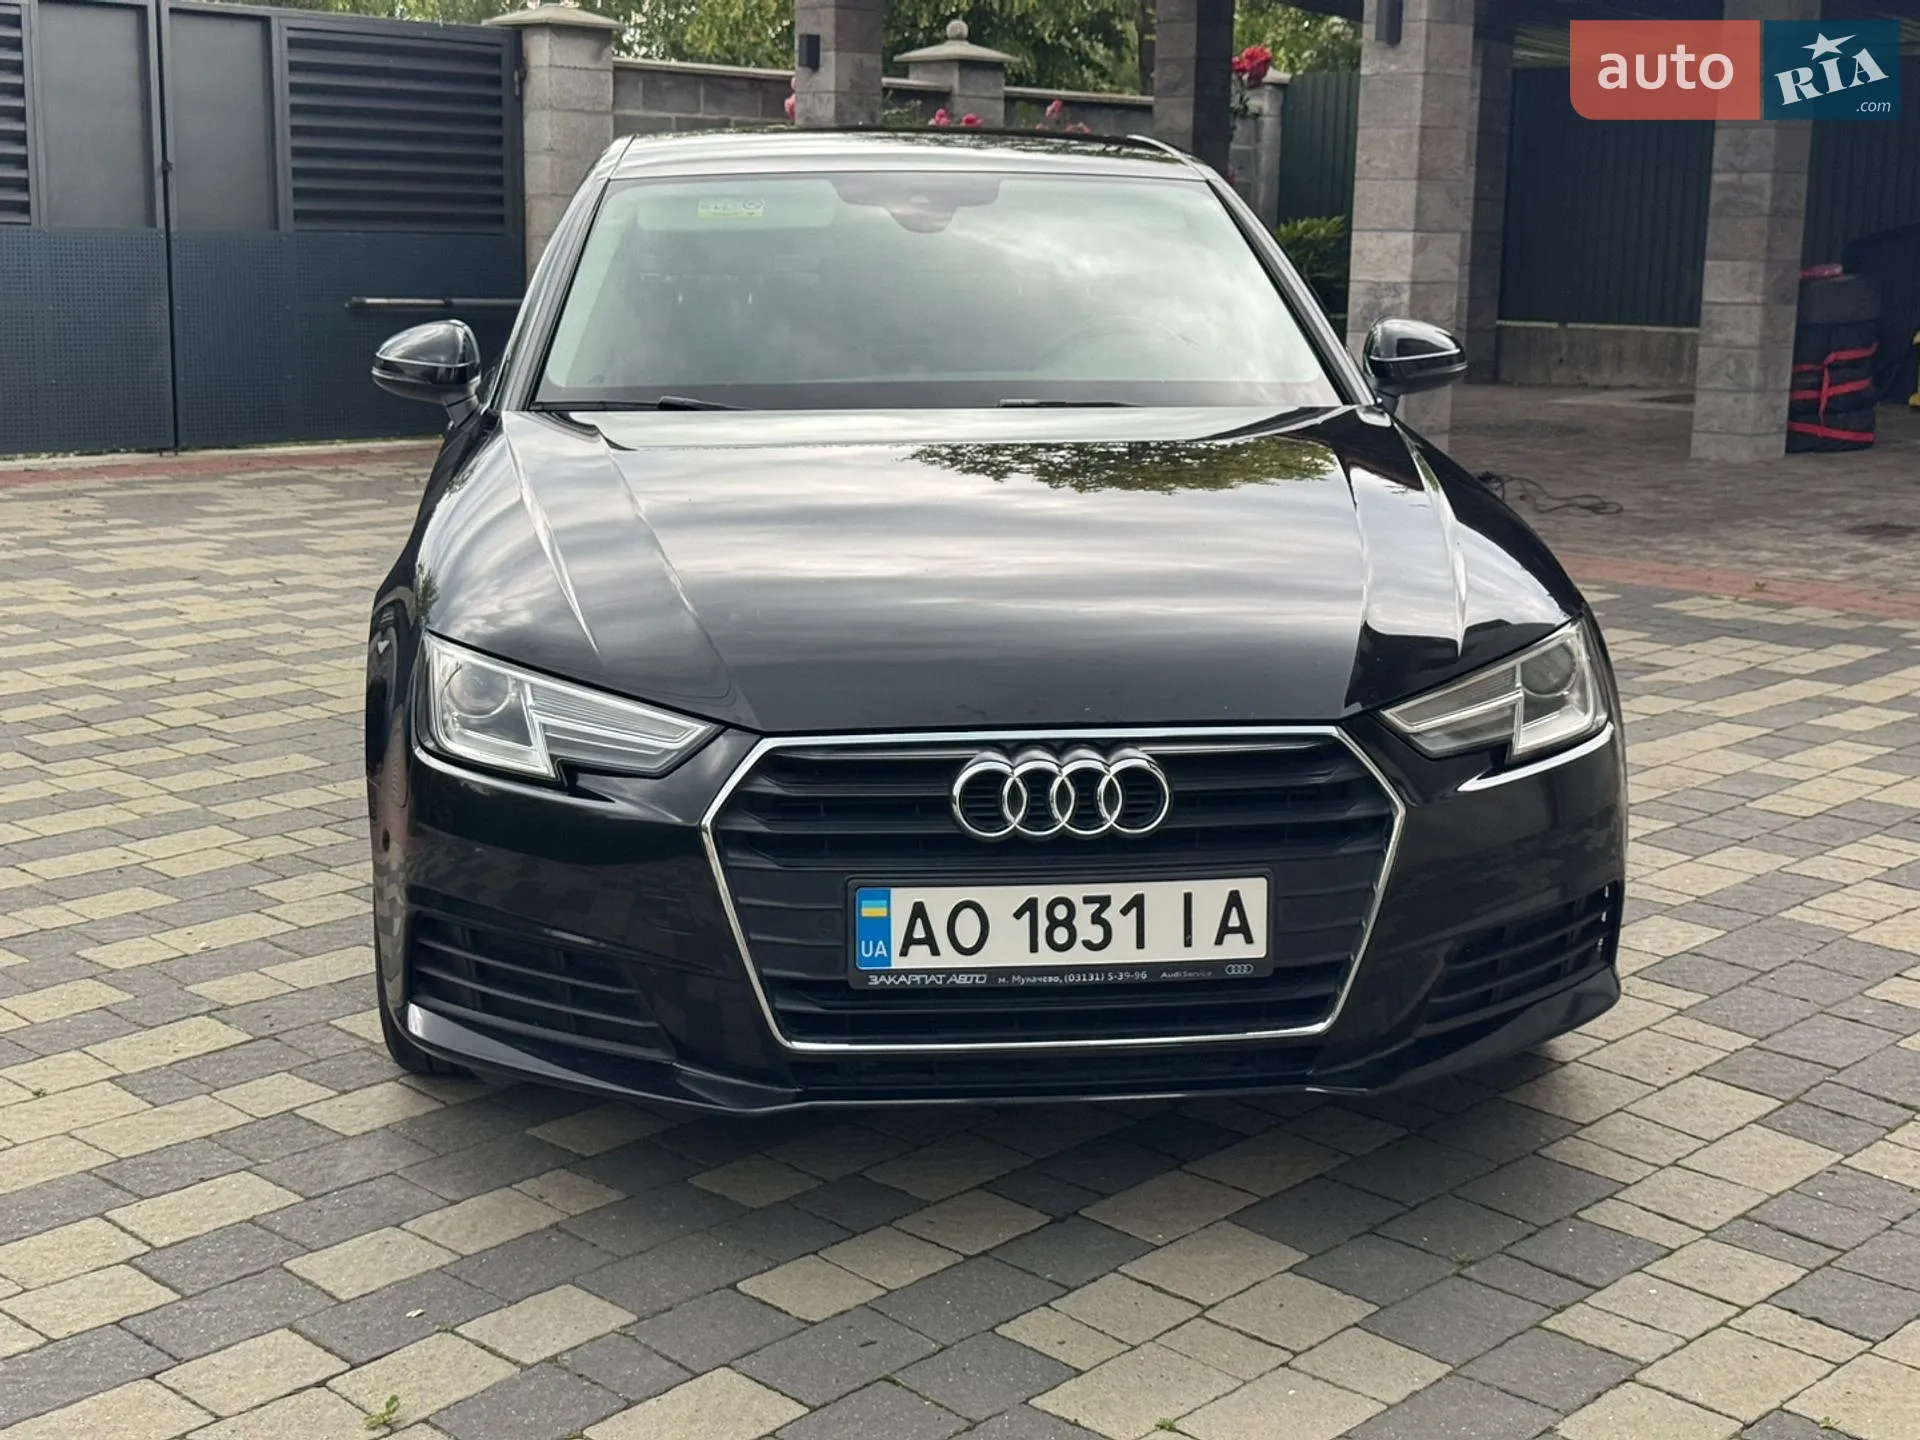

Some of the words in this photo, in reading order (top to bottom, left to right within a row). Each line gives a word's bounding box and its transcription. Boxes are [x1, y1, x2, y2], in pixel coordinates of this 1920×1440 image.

[899, 898, 991, 958] AO
[1013, 893, 1146, 954] 1831
[861, 940, 888, 958] UA
[868, 974, 946, 986] ЗАКАРПАТ
[1064, 972, 1104, 984] (03131)
[1107, 970, 1148, 982] 5-39-96
